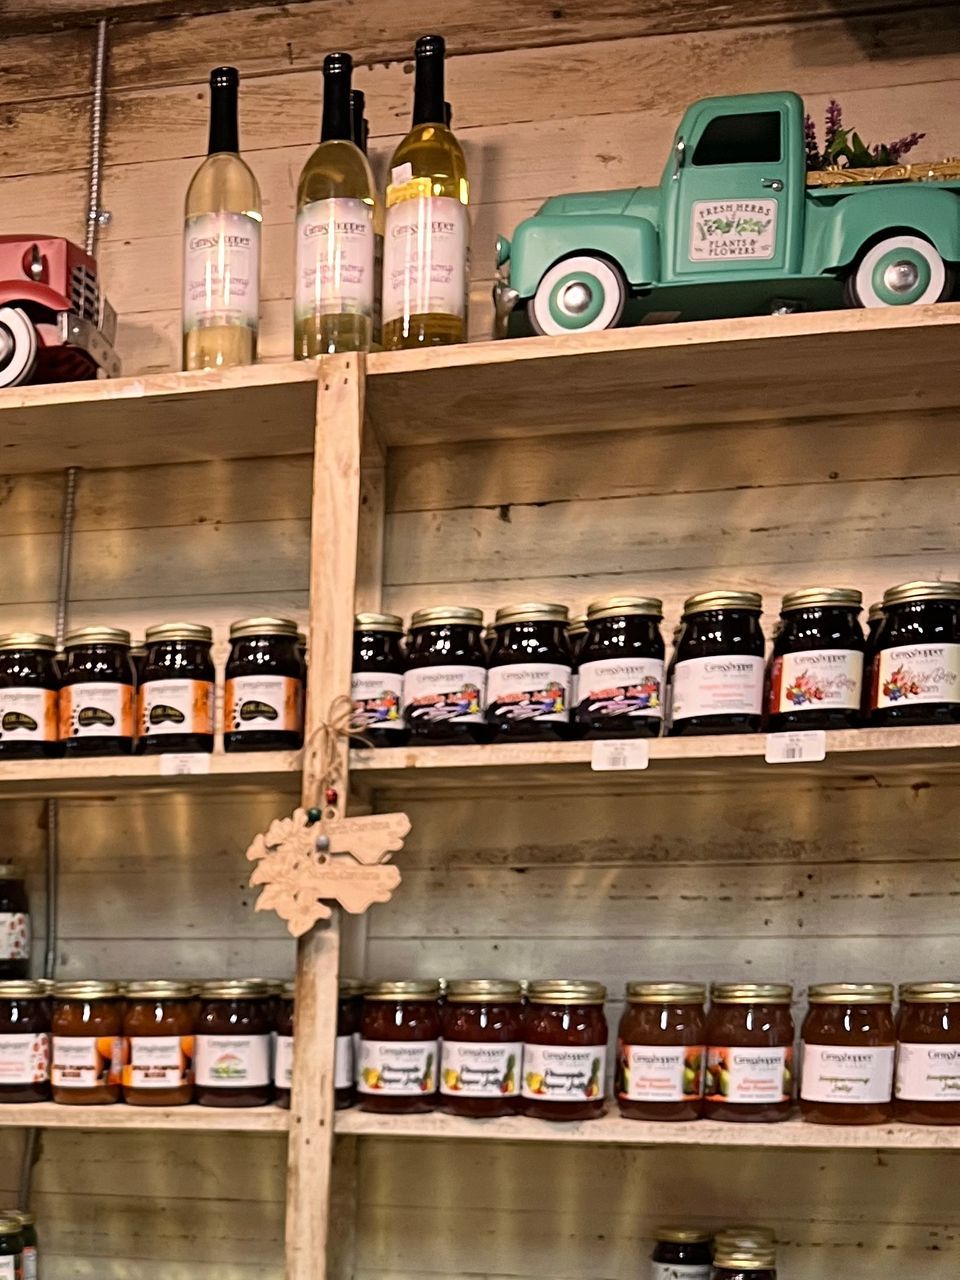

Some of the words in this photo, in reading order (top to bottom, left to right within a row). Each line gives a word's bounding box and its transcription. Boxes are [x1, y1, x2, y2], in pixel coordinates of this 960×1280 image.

[699, 204, 733, 219] FRESH
[736, 203, 771, 217] HERBS
[709, 240, 748, 249] PLANTS
[749, 239, 757, 247] &
[708, 247, 756, 256] FLOWERS
